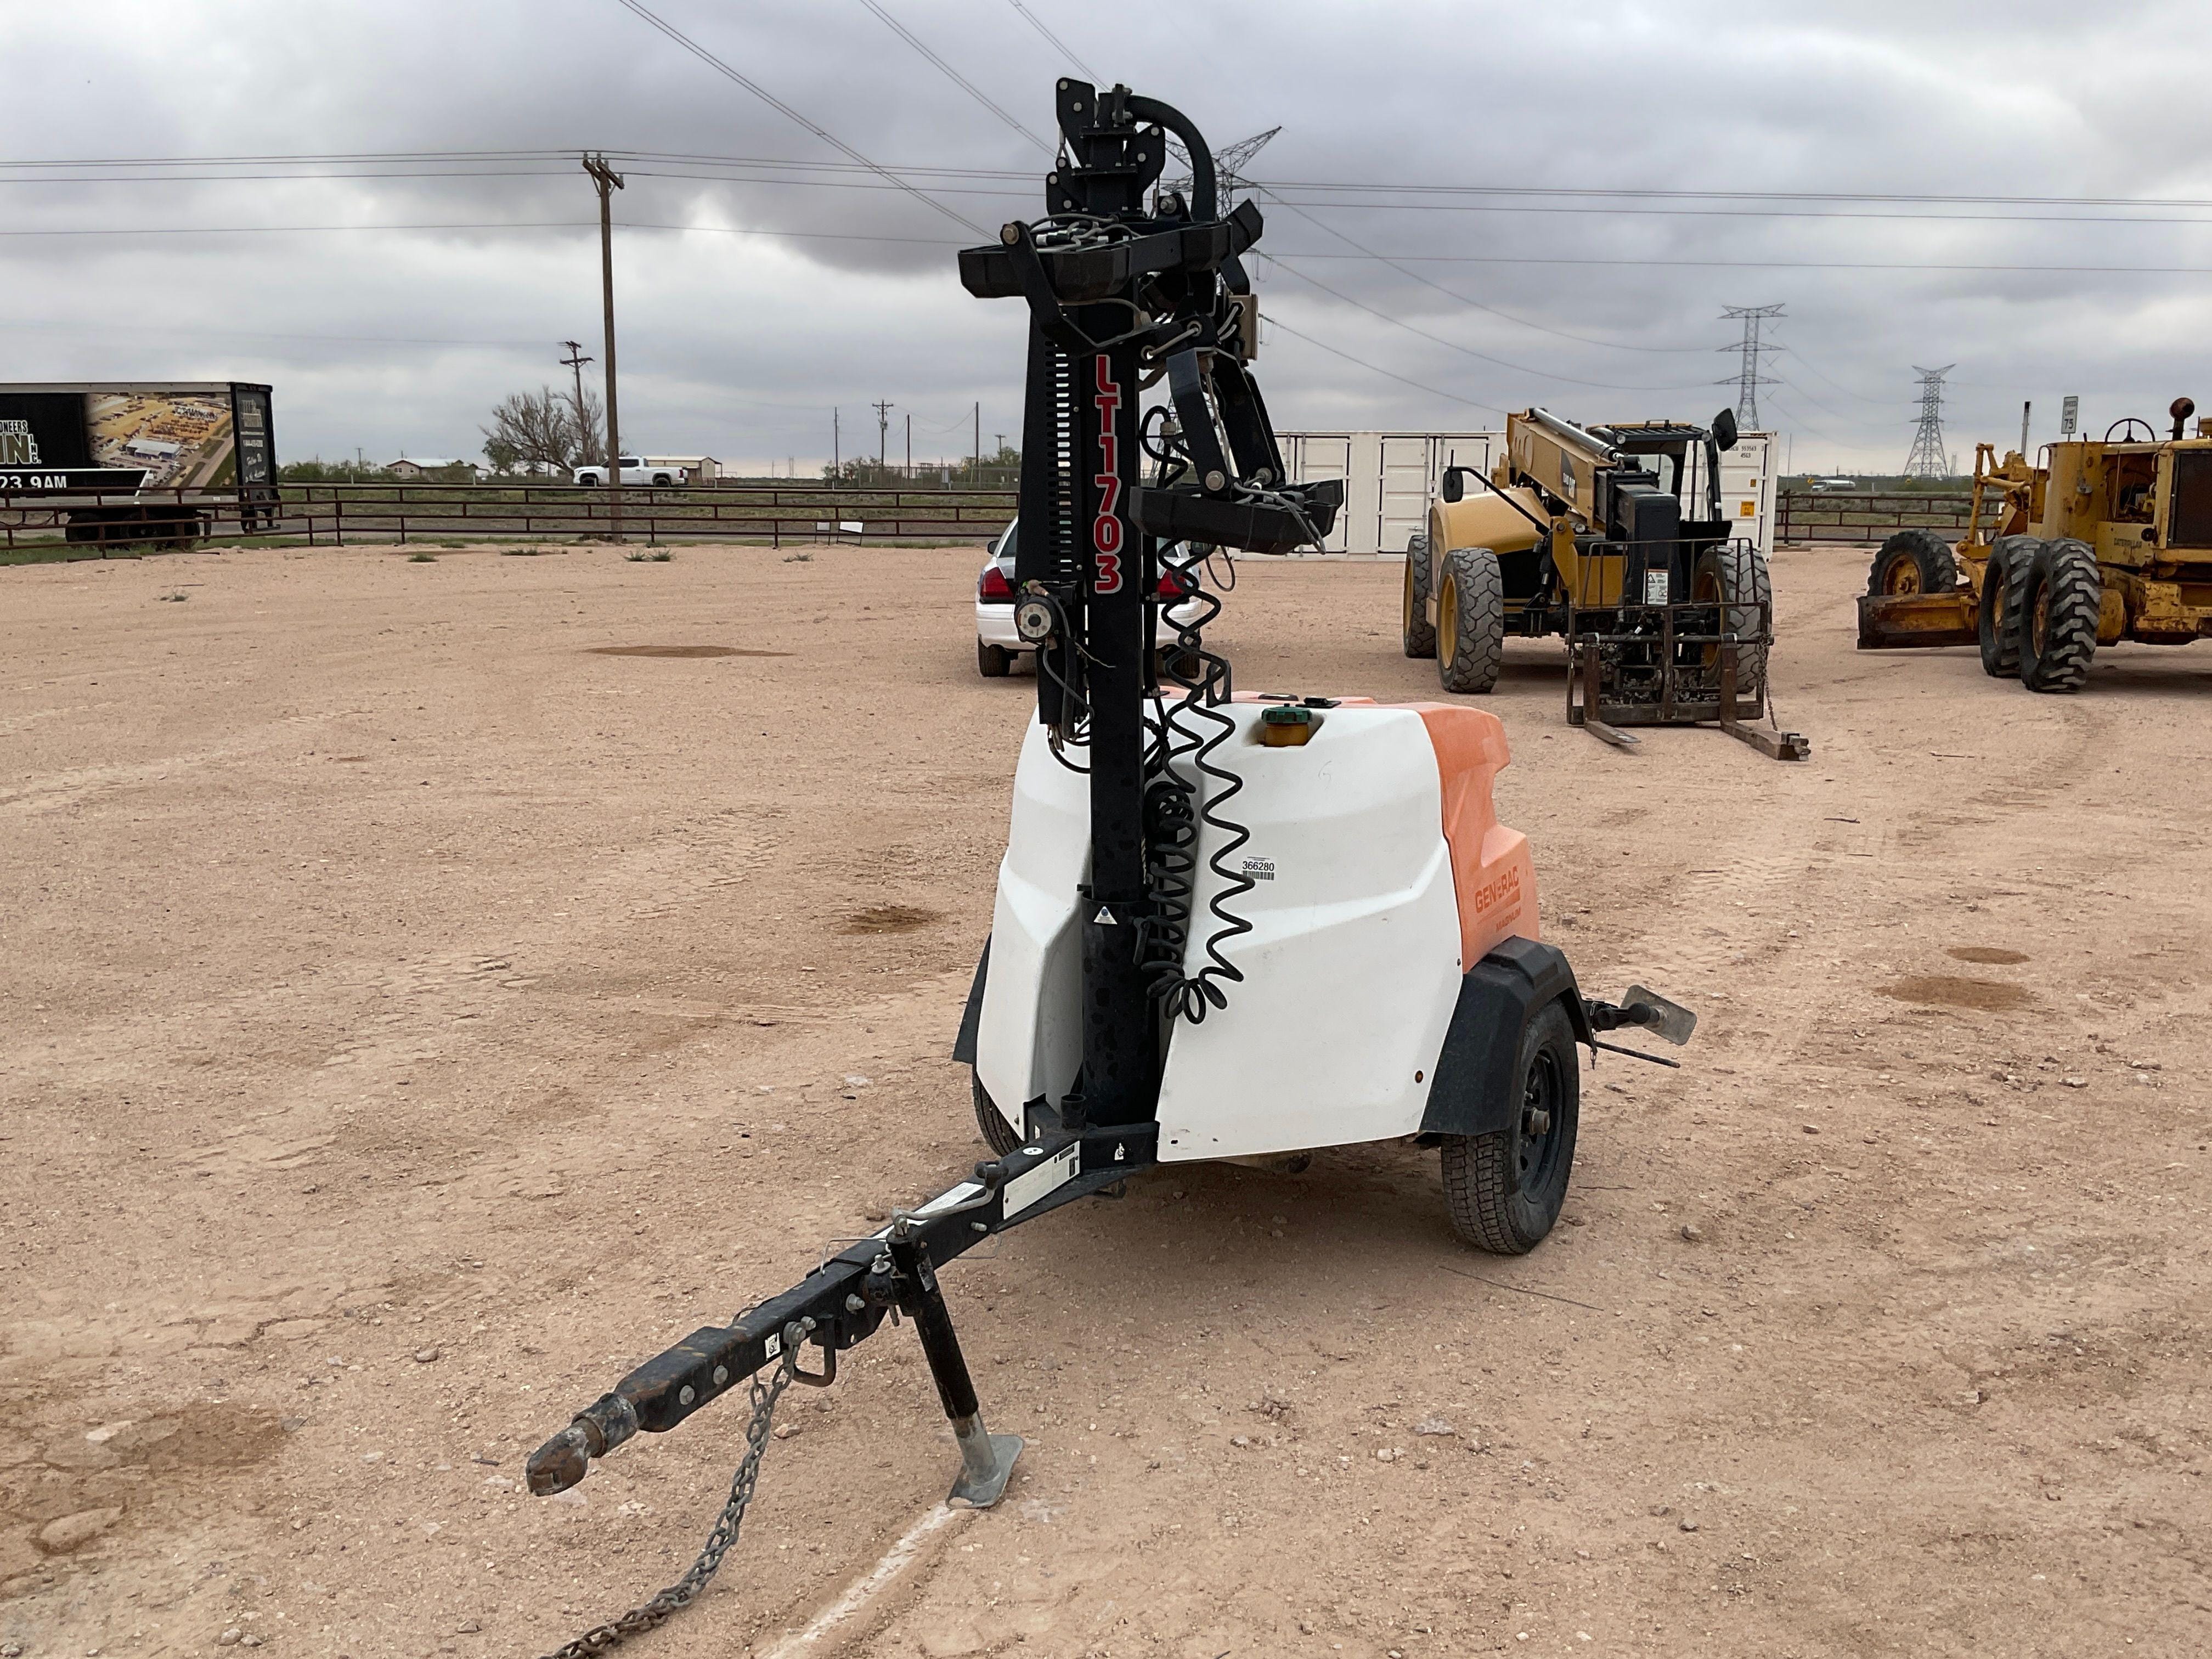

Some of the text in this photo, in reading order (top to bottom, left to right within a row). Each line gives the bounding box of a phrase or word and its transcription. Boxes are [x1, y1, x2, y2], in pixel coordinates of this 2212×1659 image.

[2064, 419, 2073, 429] 75
[1094, 354, 1123, 594] LT1703
[30, 476, 67, 488] 9AM
[1242, 861, 1274, 871] 366280
[1475, 866, 1519, 913] GENERAC
